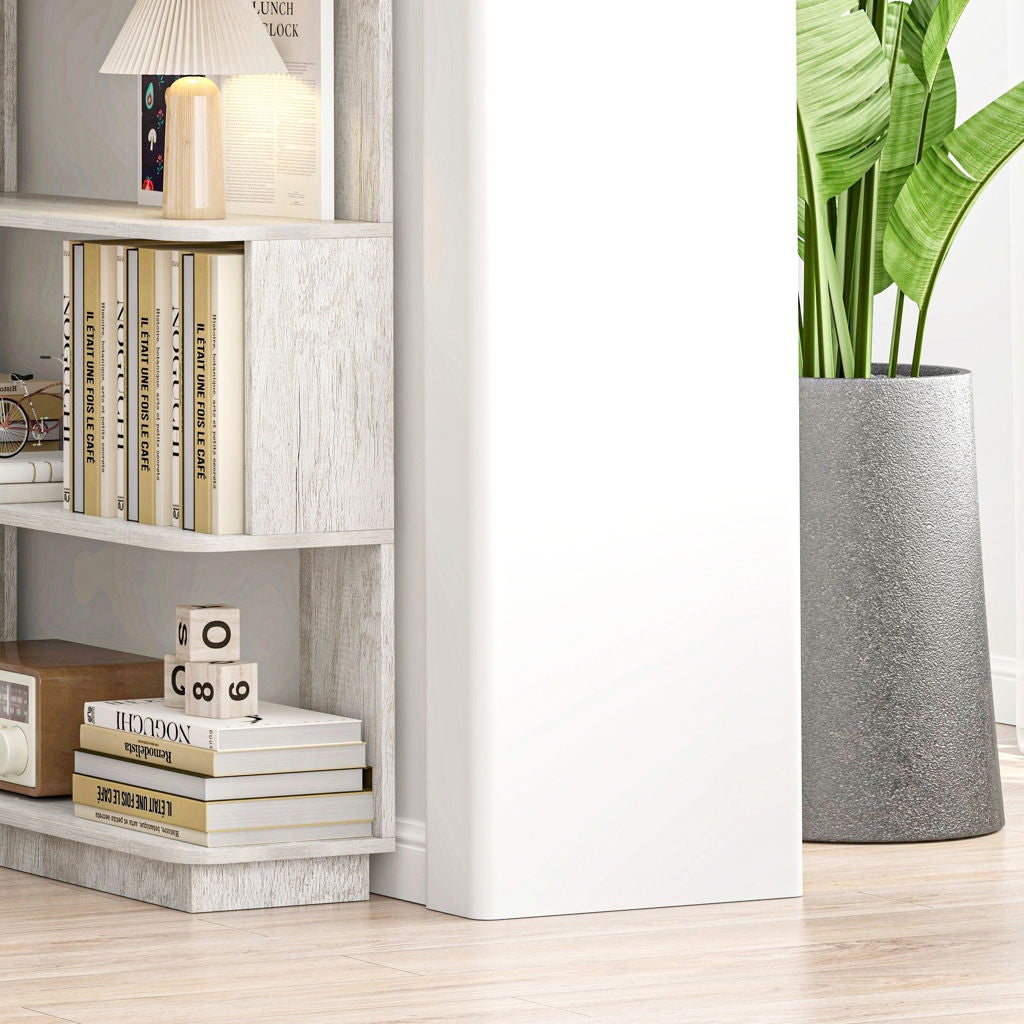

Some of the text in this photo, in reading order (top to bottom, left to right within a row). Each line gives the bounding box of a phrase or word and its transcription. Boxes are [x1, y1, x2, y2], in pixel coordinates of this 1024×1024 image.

[86, 311, 95, 464] IL ÉTAIT UNE FOIS LE CAFÉ
[141, 317, 150, 471] IL ÉTAIT UNE FOIS LE CAFÉ
[197, 323, 206, 479] IL ÉTAIT UNE FOIS LE CAFÉ
[192, 681, 214, 702] 8
[116, 711, 191, 744] NOGUCHI
[124, 741, 172, 764] Remodelista
[97, 786, 148, 811] UNE FOIS LE CAFÉ
